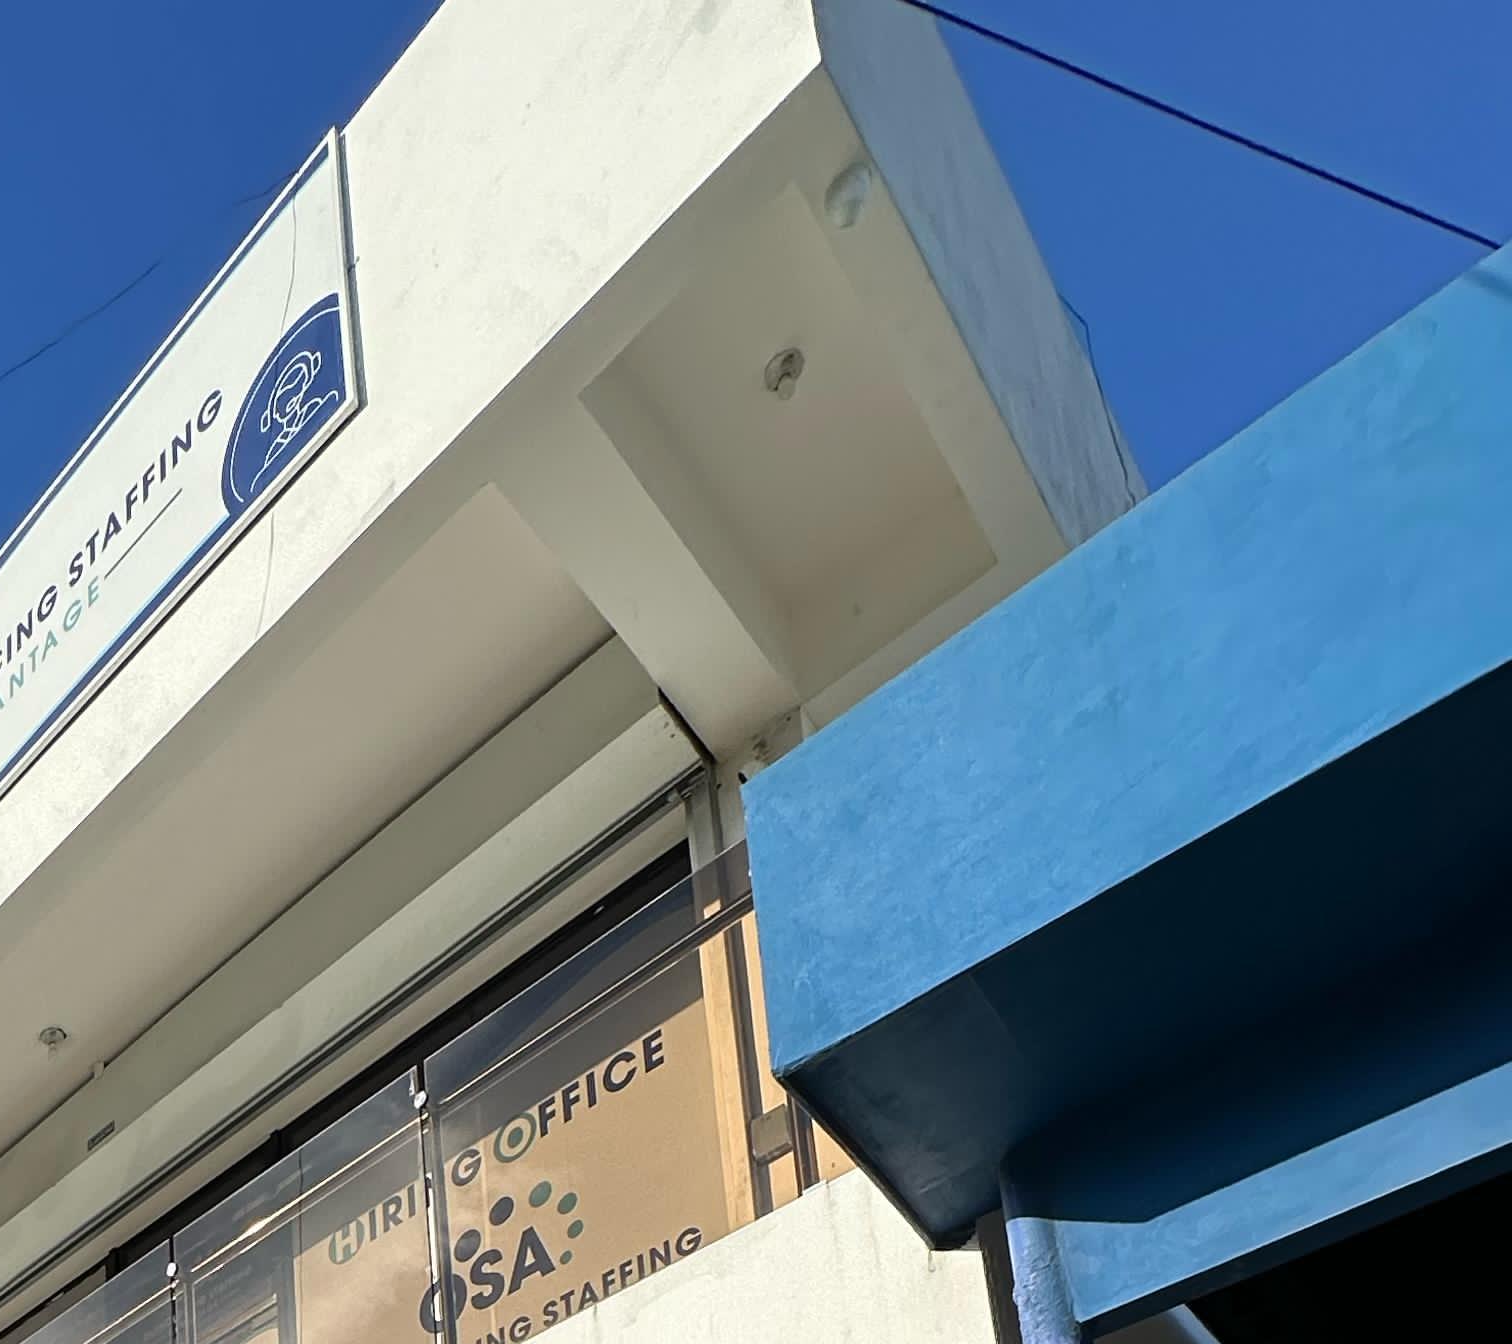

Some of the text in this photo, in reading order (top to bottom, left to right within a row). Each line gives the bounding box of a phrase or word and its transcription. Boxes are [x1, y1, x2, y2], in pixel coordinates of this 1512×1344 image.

[67, 388, 224, 586] STAFFING
[327, 1030, 665, 1266] HIRIG OFFICE
[419, 1225, 557, 1335] OSA
[543, 1226, 703, 1328] STAFFING
